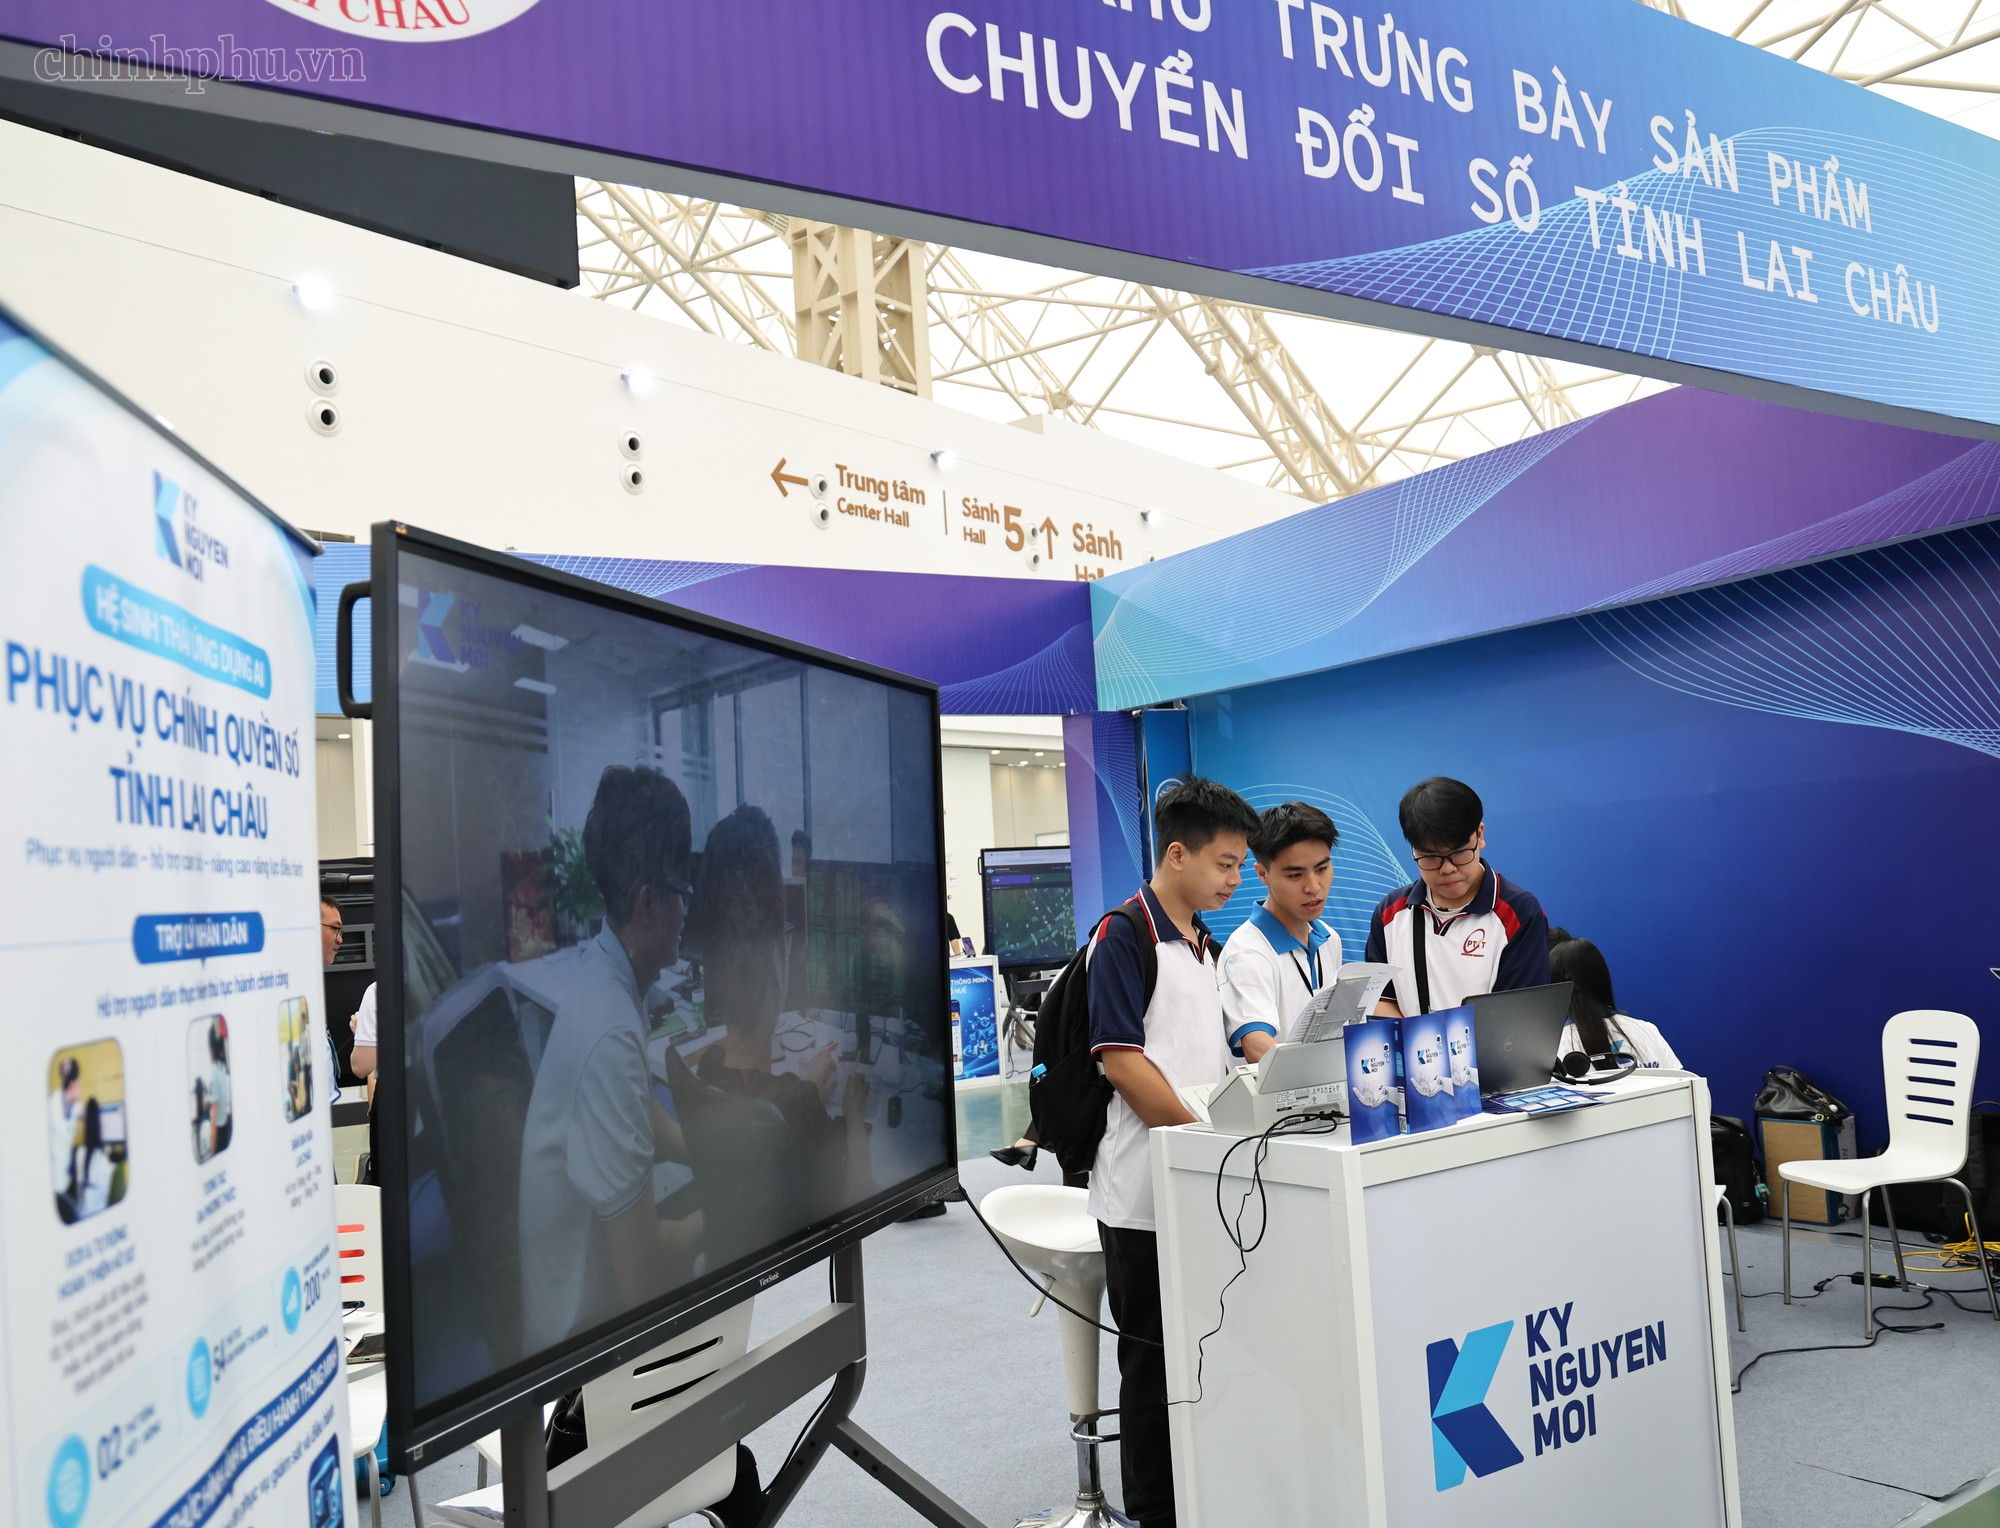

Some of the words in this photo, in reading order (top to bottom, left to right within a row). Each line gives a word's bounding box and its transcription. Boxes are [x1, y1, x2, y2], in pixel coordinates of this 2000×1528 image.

[1276, 0, 1474, 114] TRƯNG
[1512, 65, 1613, 155] BÀY
[1650, 109, 1739, 194] SẢN
[1767, 156, 1872, 234] PHẨM
[926, 12, 1249, 160] CHUYỂN
[1296, 103, 1425, 205] ĐỔI
[1469, 152, 1541, 234] SỐ
[1574, 180, 1706, 276] TỈNH
[1737, 230, 1818, 304] LAI
[1844, 264, 1940, 334] CHÂU
[835, 463, 889, 502] Trung
[892, 481, 925, 506] tâm
[962, 497, 1000, 524] Sảnh
[837, 499, 881, 522] Center
[884, 507, 909, 528] Hall
[963, 526, 986, 545] Hall
[1004, 505, 1025, 552] 5
[1072, 522, 1122, 560] Sảnh
[5, 641, 103, 733] PHỤC
[109, 671, 146, 748] VỤ
[154, 686, 218, 757] CHÍNH
[109, 751, 174, 829] TỈNH
[179, 779, 206, 834] LAI
[211, 782, 268, 840] CHÂU
[304, 1271, 321, 1313] 200
[1525, 1301, 1574, 1358] KY
[1529, 1320, 1667, 1408] NGUYEN
[1533, 1393, 1597, 1457] MOI
